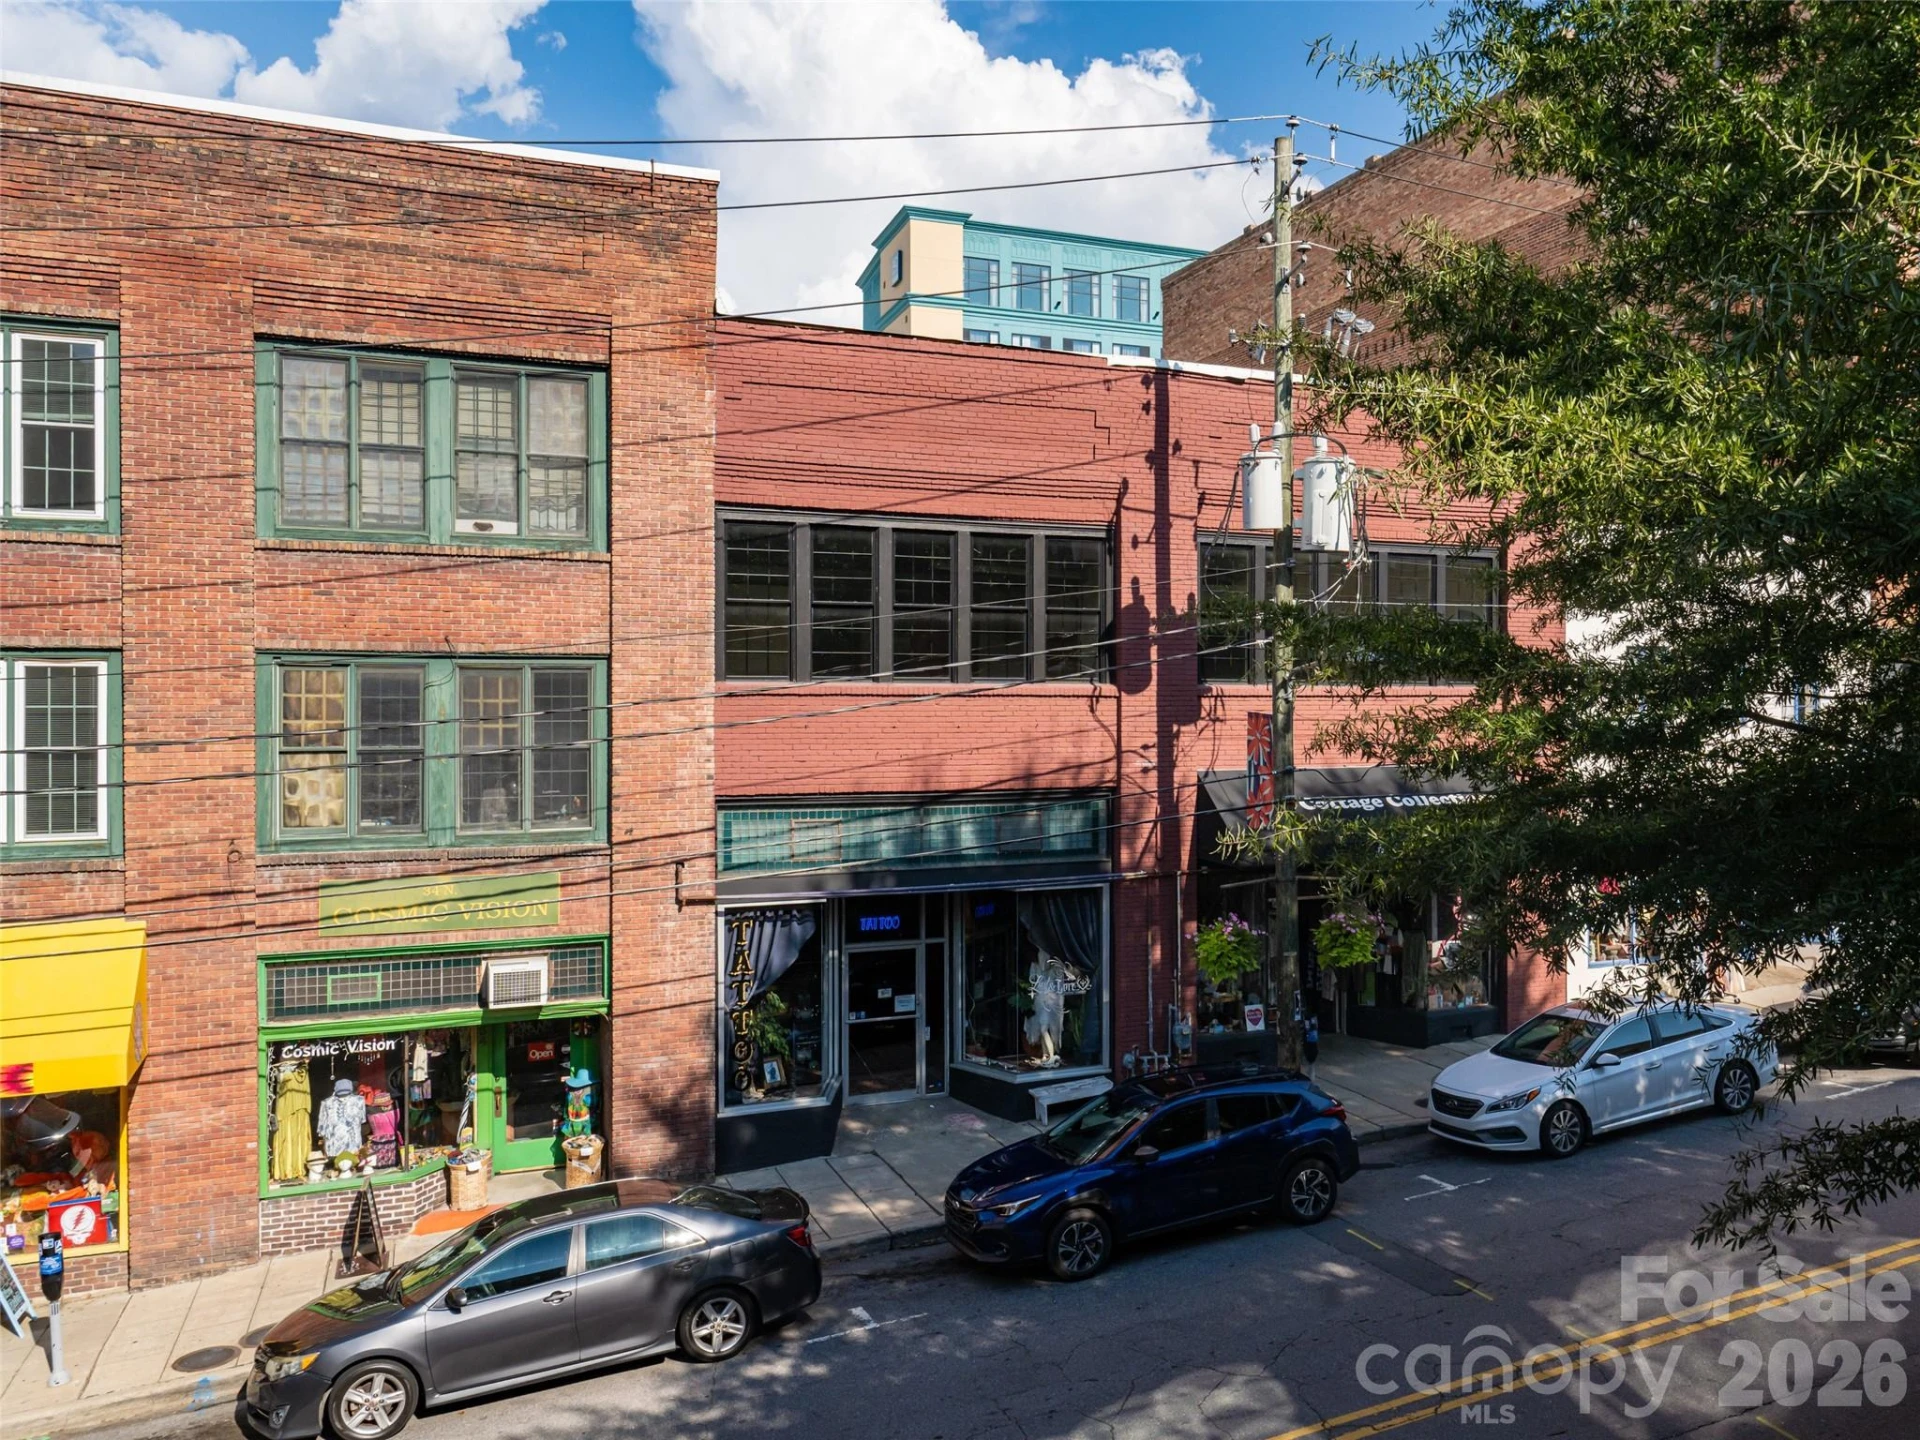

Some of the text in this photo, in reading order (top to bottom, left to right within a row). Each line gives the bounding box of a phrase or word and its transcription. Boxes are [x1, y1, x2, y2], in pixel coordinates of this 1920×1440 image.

[1299, 797, 1384, 811] Cottage
[422, 886, 439, 896] 34
[333, 900, 548, 925] COSMIC VISION
[282, 1039, 396, 1059] Cosmic Vision
[529, 1049, 554, 1060] Open
